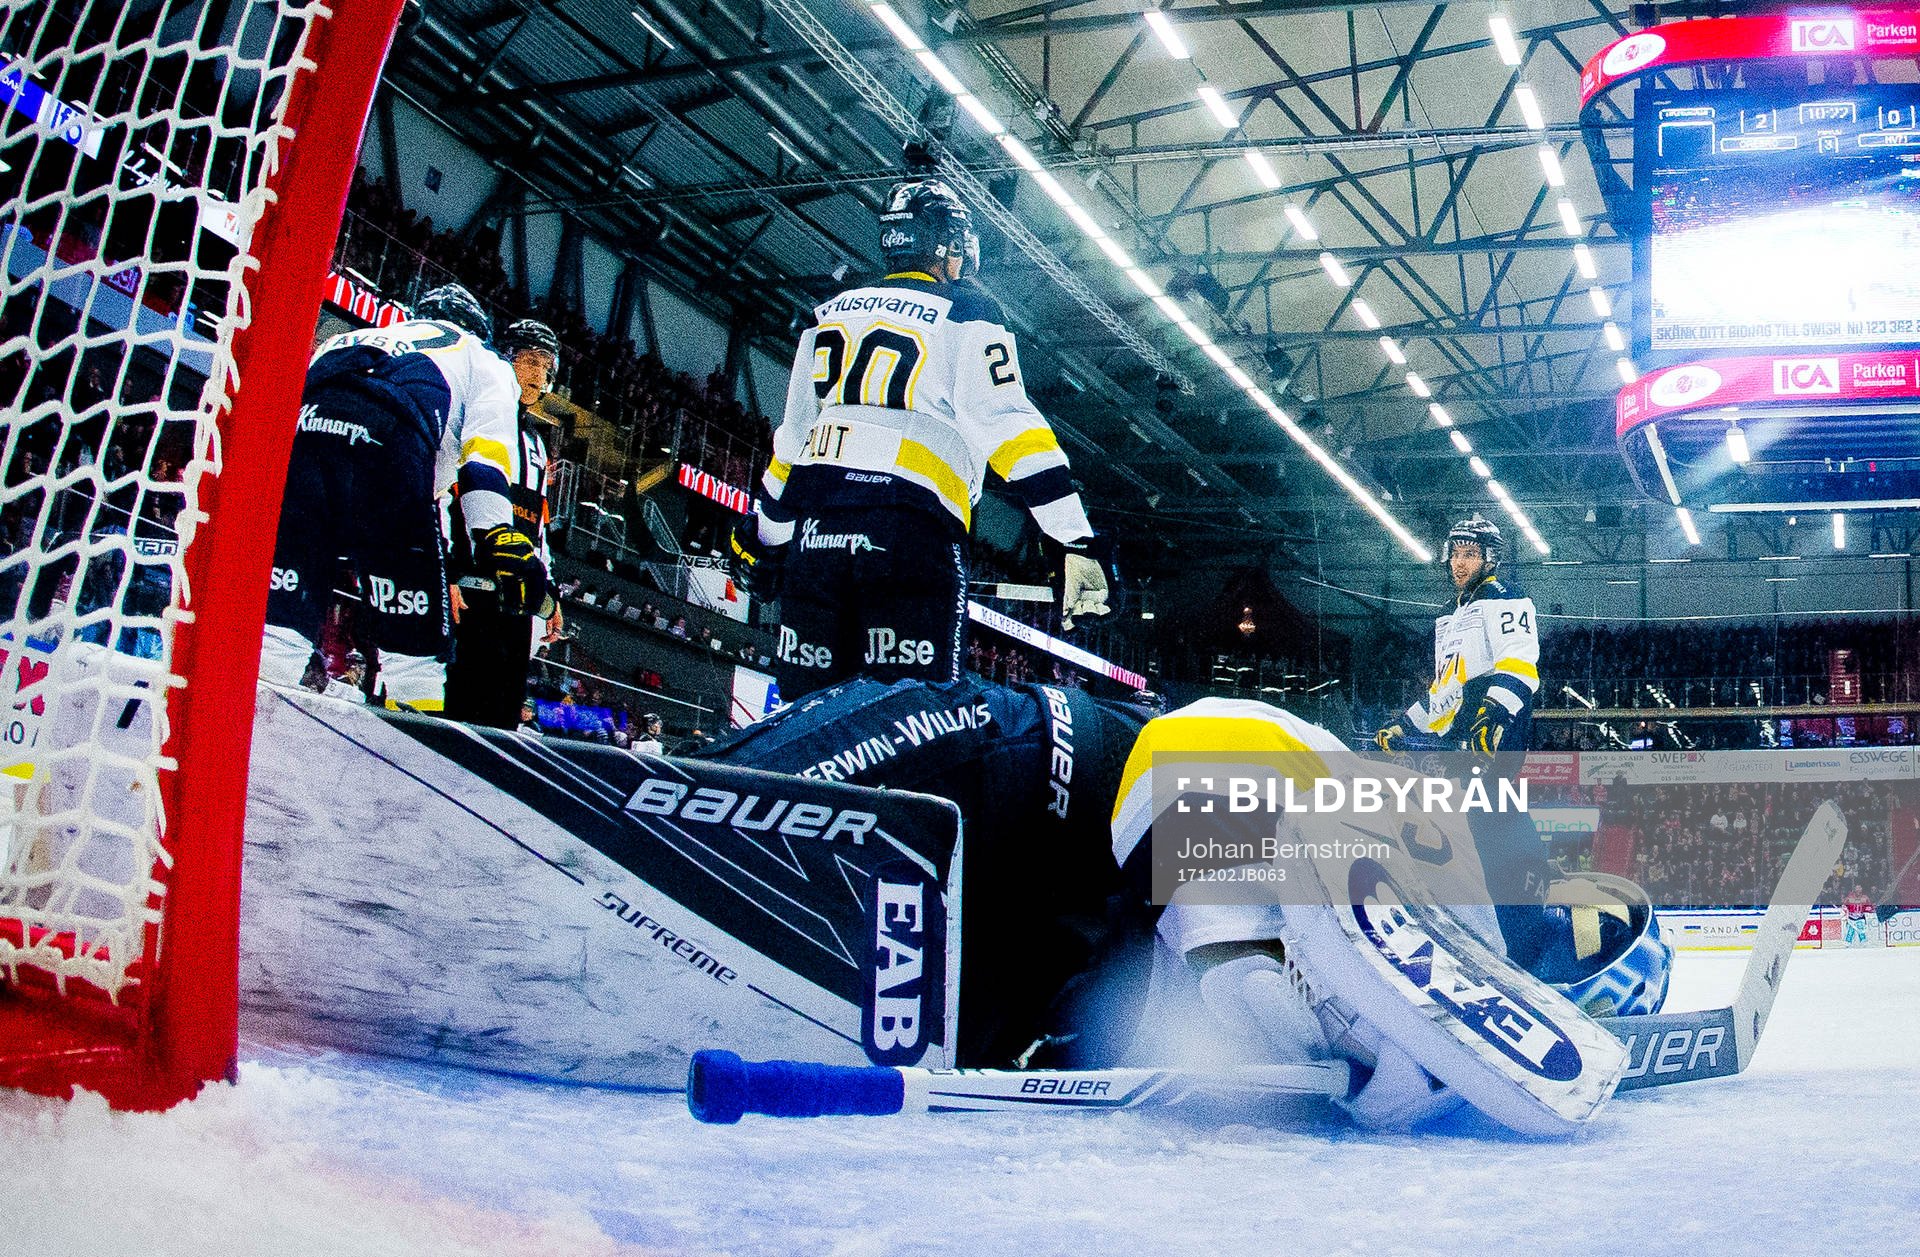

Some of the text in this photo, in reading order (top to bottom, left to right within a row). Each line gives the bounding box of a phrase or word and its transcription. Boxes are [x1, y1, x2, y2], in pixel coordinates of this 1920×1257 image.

[1799, 25, 1848, 46] ICA
[1867, 23, 1917, 37] Parken
[1755, 113, 1767, 129] 2
[1888, 110, 1900, 125] 0
[1782, 364, 1833, 389] ICA
[1853, 363, 1906, 379] Parken
[297, 404, 384, 446] Kinnarps
[845, 472, 892, 485] BAUER
[800, 517, 886, 555] Kinnarps
[369, 574, 429, 616] JP.se
[951, 542, 967, 682] HERWIN-WILLIAMS
[1500, 610, 1532, 635] 24
[777, 625, 832, 669] JP.se
[864, 628, 935, 666] JP.se
[1041, 685, 1074, 819] BAUER
[1850, 751, 1909, 764] ESSWEGE
[625, 777, 878, 846] BAUER
[594, 892, 738, 987] SUPREME
[873, 878, 925, 1051] EAB
[1020, 1078, 1112, 1096] BAUER
